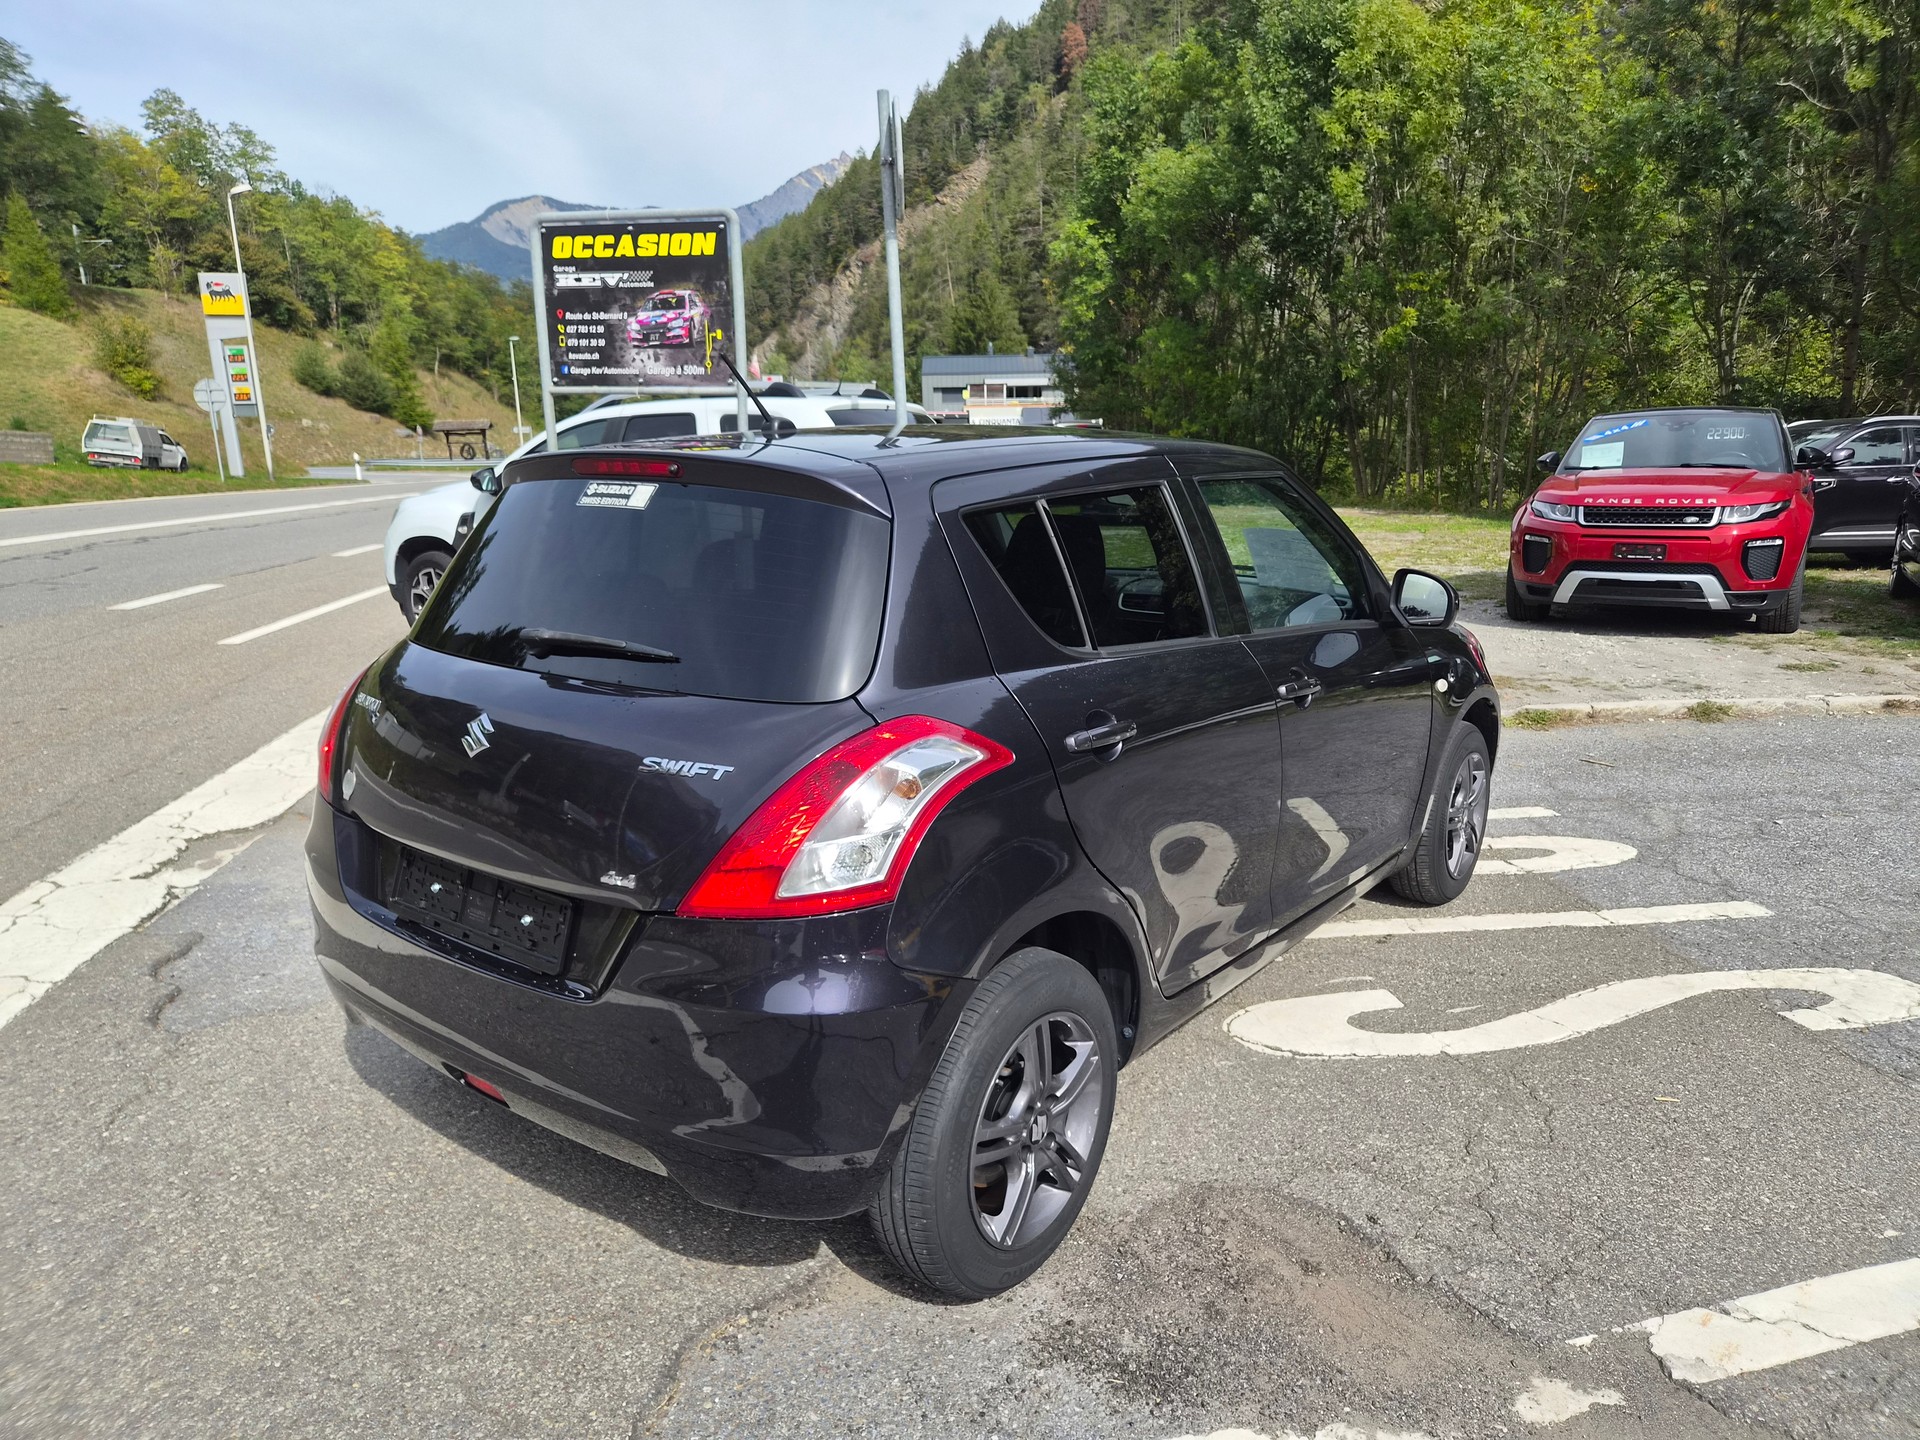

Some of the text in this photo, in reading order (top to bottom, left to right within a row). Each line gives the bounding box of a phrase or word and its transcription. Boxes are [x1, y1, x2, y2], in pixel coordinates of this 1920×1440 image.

[552, 232, 717, 259] OCCASION
[552, 265, 576, 273] Garage
[565, 311, 582, 320] Route
[583, 311, 591, 320] du
[566, 325, 577, 333] 027
[570, 366, 591, 376] Garage
[647, 365, 676, 377] Garage
[683, 365, 705, 375] 500m
[596, 484, 636, 495] SUZUKI
[580, 496, 628, 506] SWISS EDITION
[638, 756, 735, 781] SWIFT
